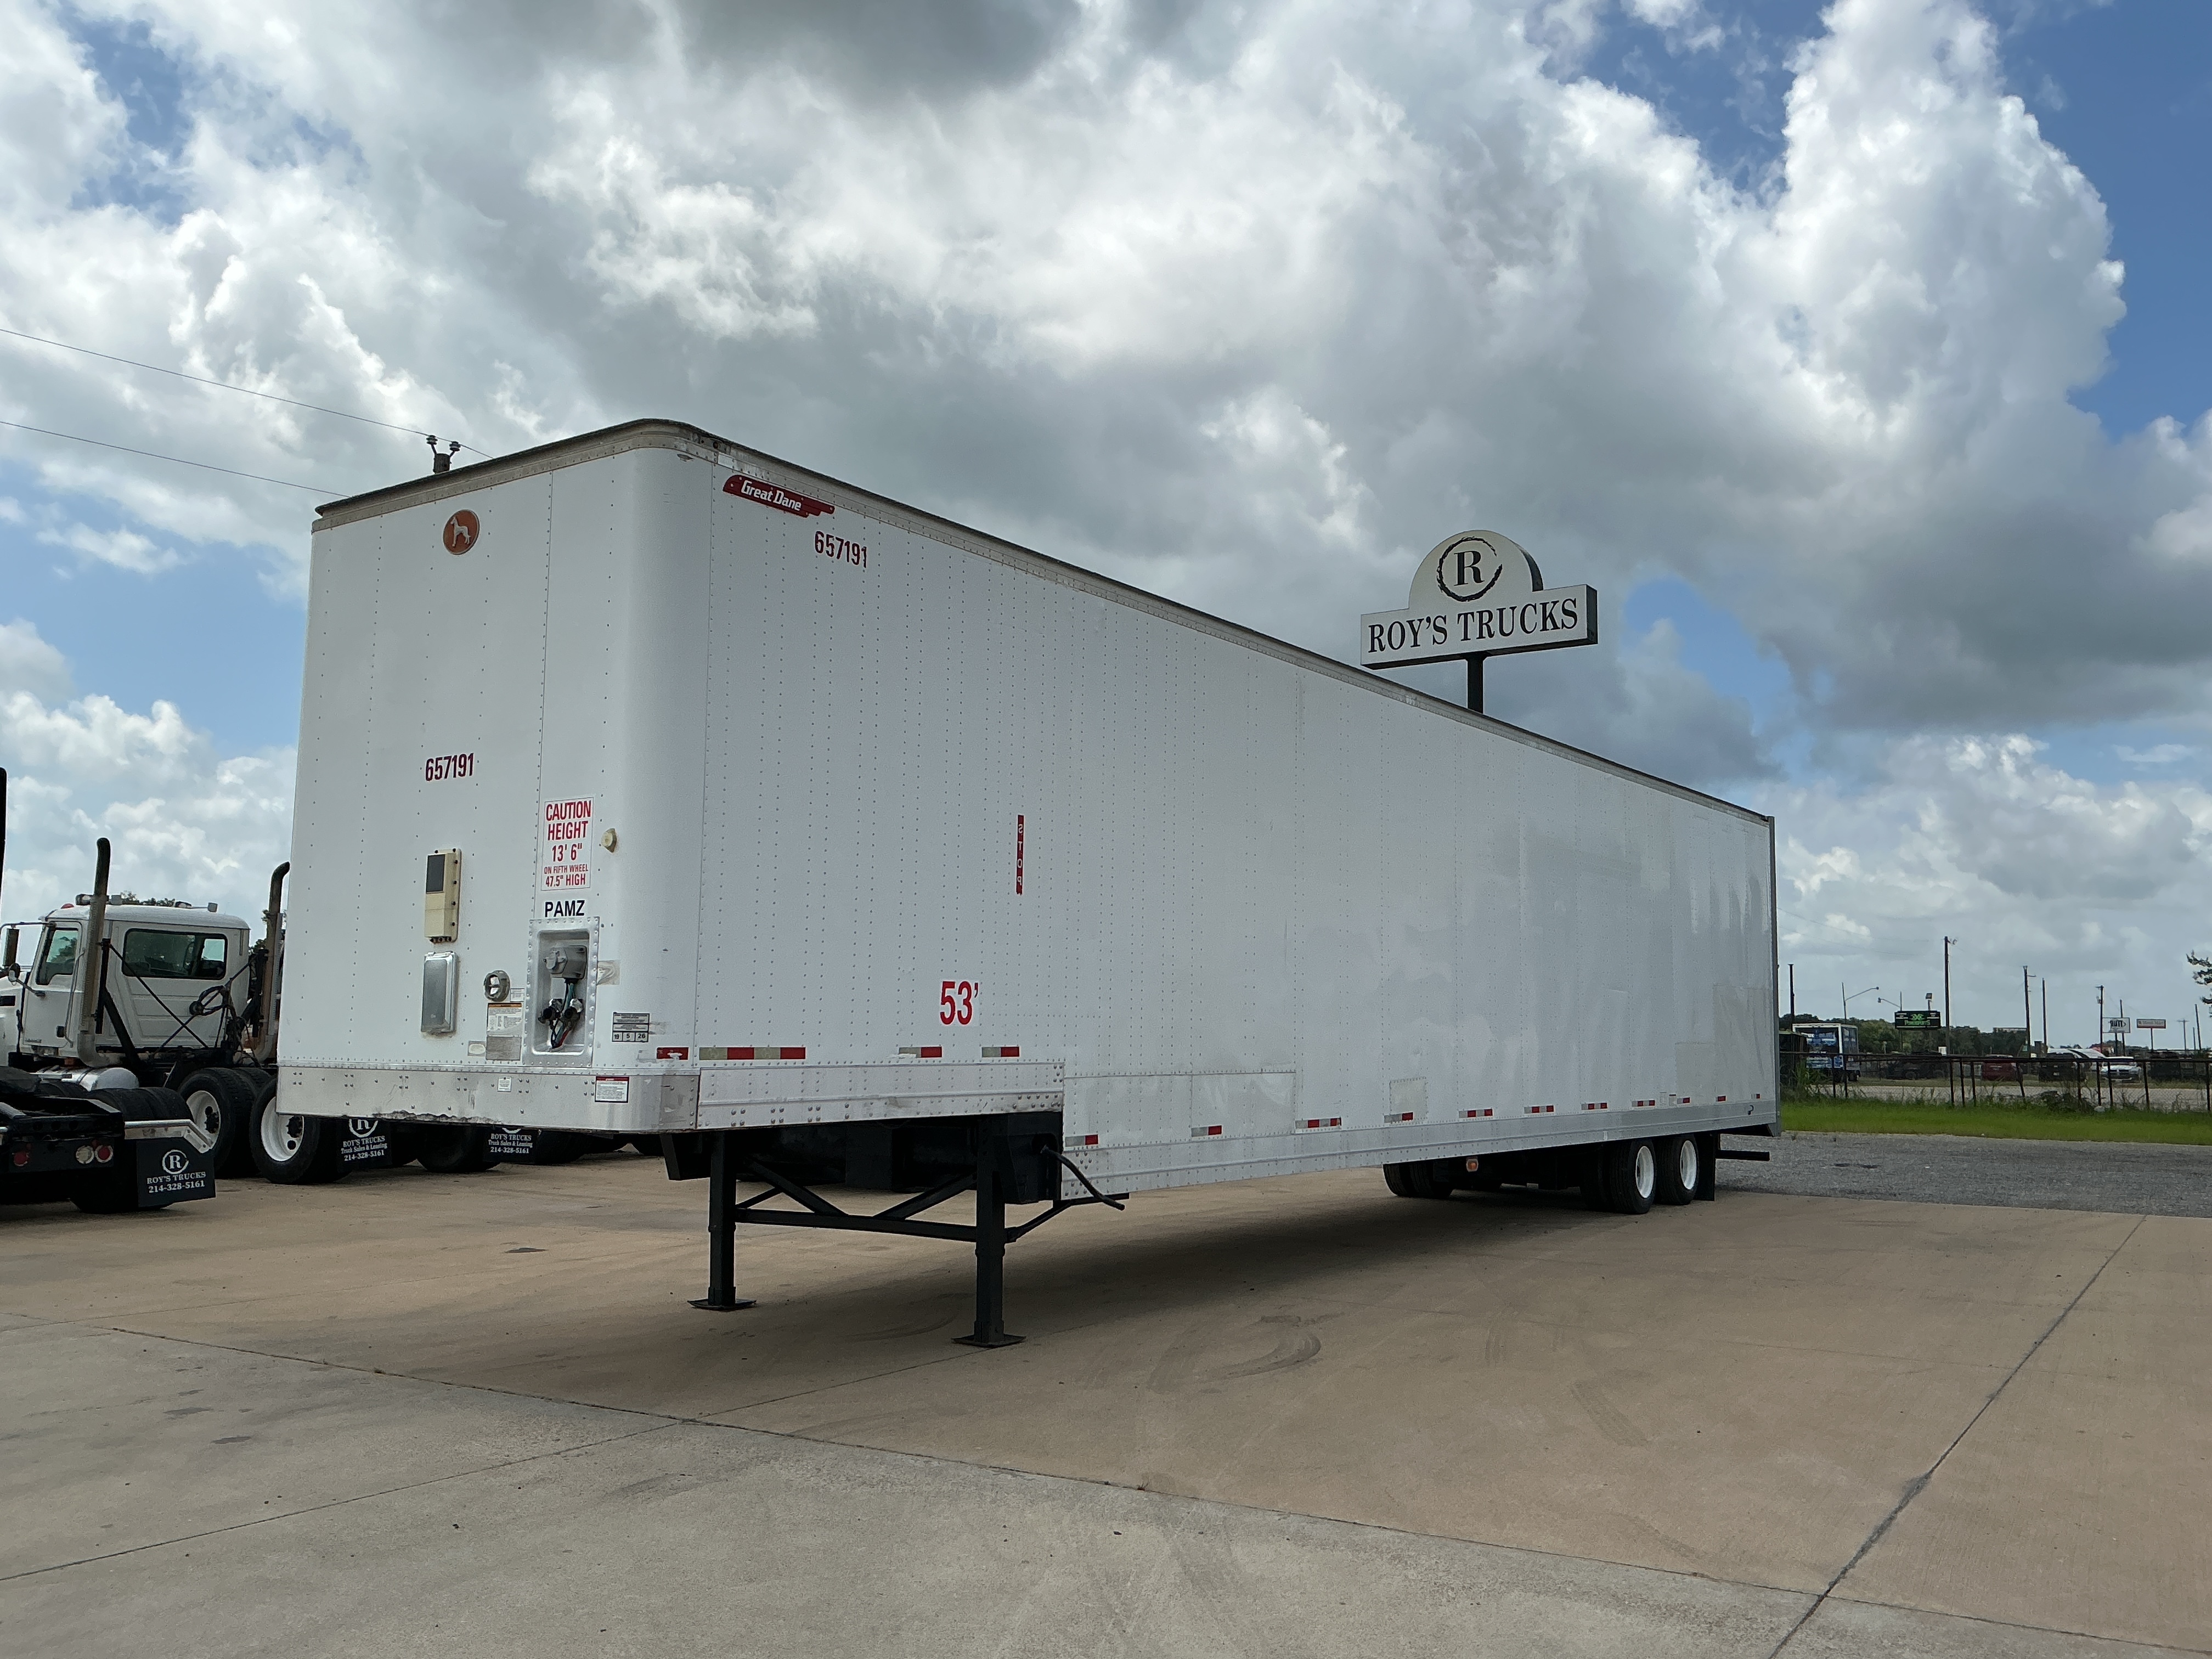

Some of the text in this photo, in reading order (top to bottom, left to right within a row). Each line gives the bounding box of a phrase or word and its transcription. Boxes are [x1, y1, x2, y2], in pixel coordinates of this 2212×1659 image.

[741, 479, 802, 511] Great Dane
[815, 531, 867, 568] 657191
[1453, 550, 1485, 586] R
[1368, 597, 1578, 653] ROY'S TRUCKS
[425, 752, 475, 781] 657191
[546, 800, 591, 821] CAUTION
[548, 820, 589, 841] HEIGHT
[552, 843, 567, 862] 13'
[544, 864, 589, 874] ON FIFTH WHEEL
[566, 873, 586, 886] HIGH
[545, 900, 585, 918] PAMZ
[343, 1136, 386, 1148] ROY'S TRUCKS
[168, 1155, 182, 1169] R
[344, 1149, 385, 1161] 214-328-5161
[146, 1171, 206, 1184] ROY'S TRUCKS
[148, 1180, 205, 1193] 214-328-5161
